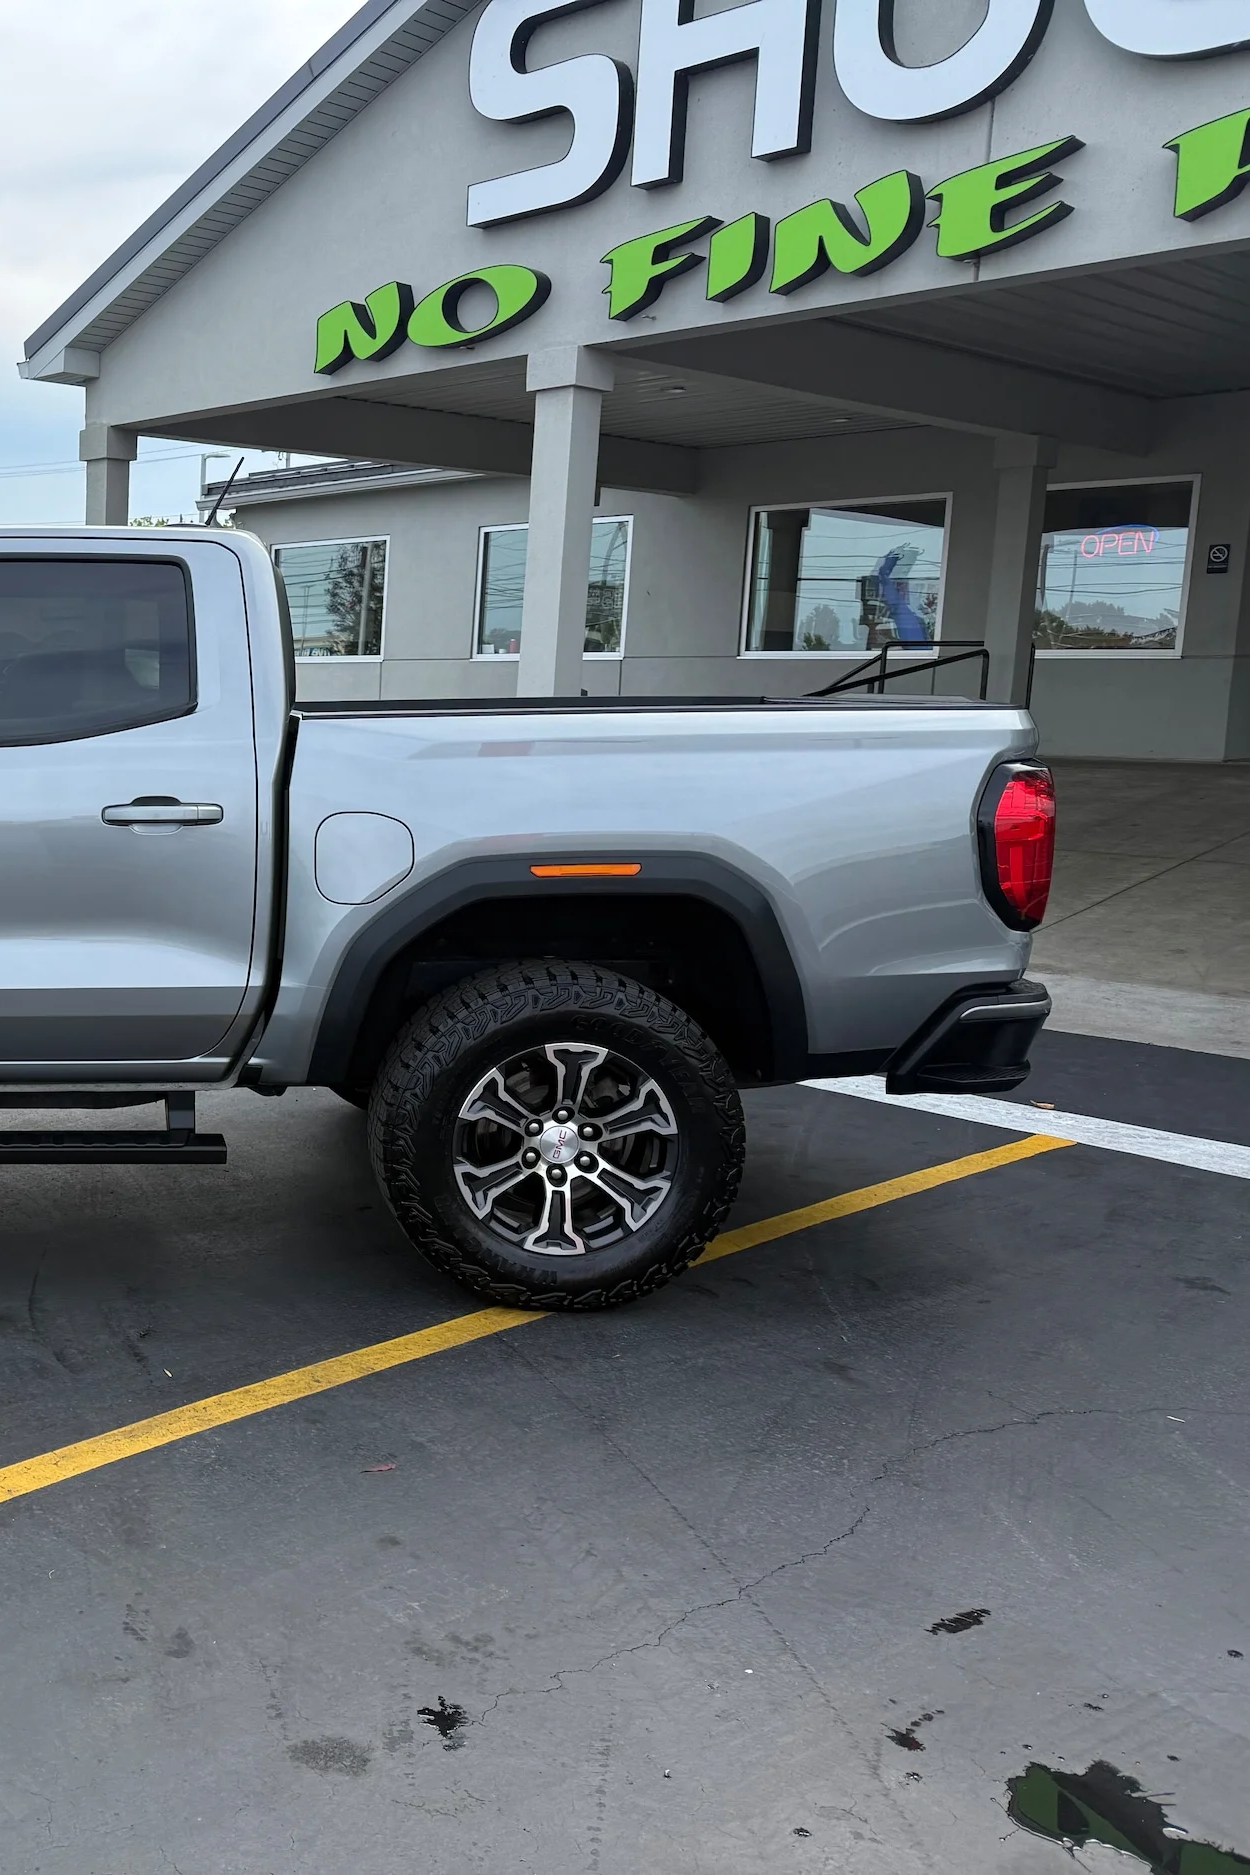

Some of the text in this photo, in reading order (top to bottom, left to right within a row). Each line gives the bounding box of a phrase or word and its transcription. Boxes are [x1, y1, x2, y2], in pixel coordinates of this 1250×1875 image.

[314, 264, 552, 375] NO
[600, 135, 1087, 322] FINE
[1081, 531, 1155, 558] OPEN
[552, 1129, 567, 1159] GMC
